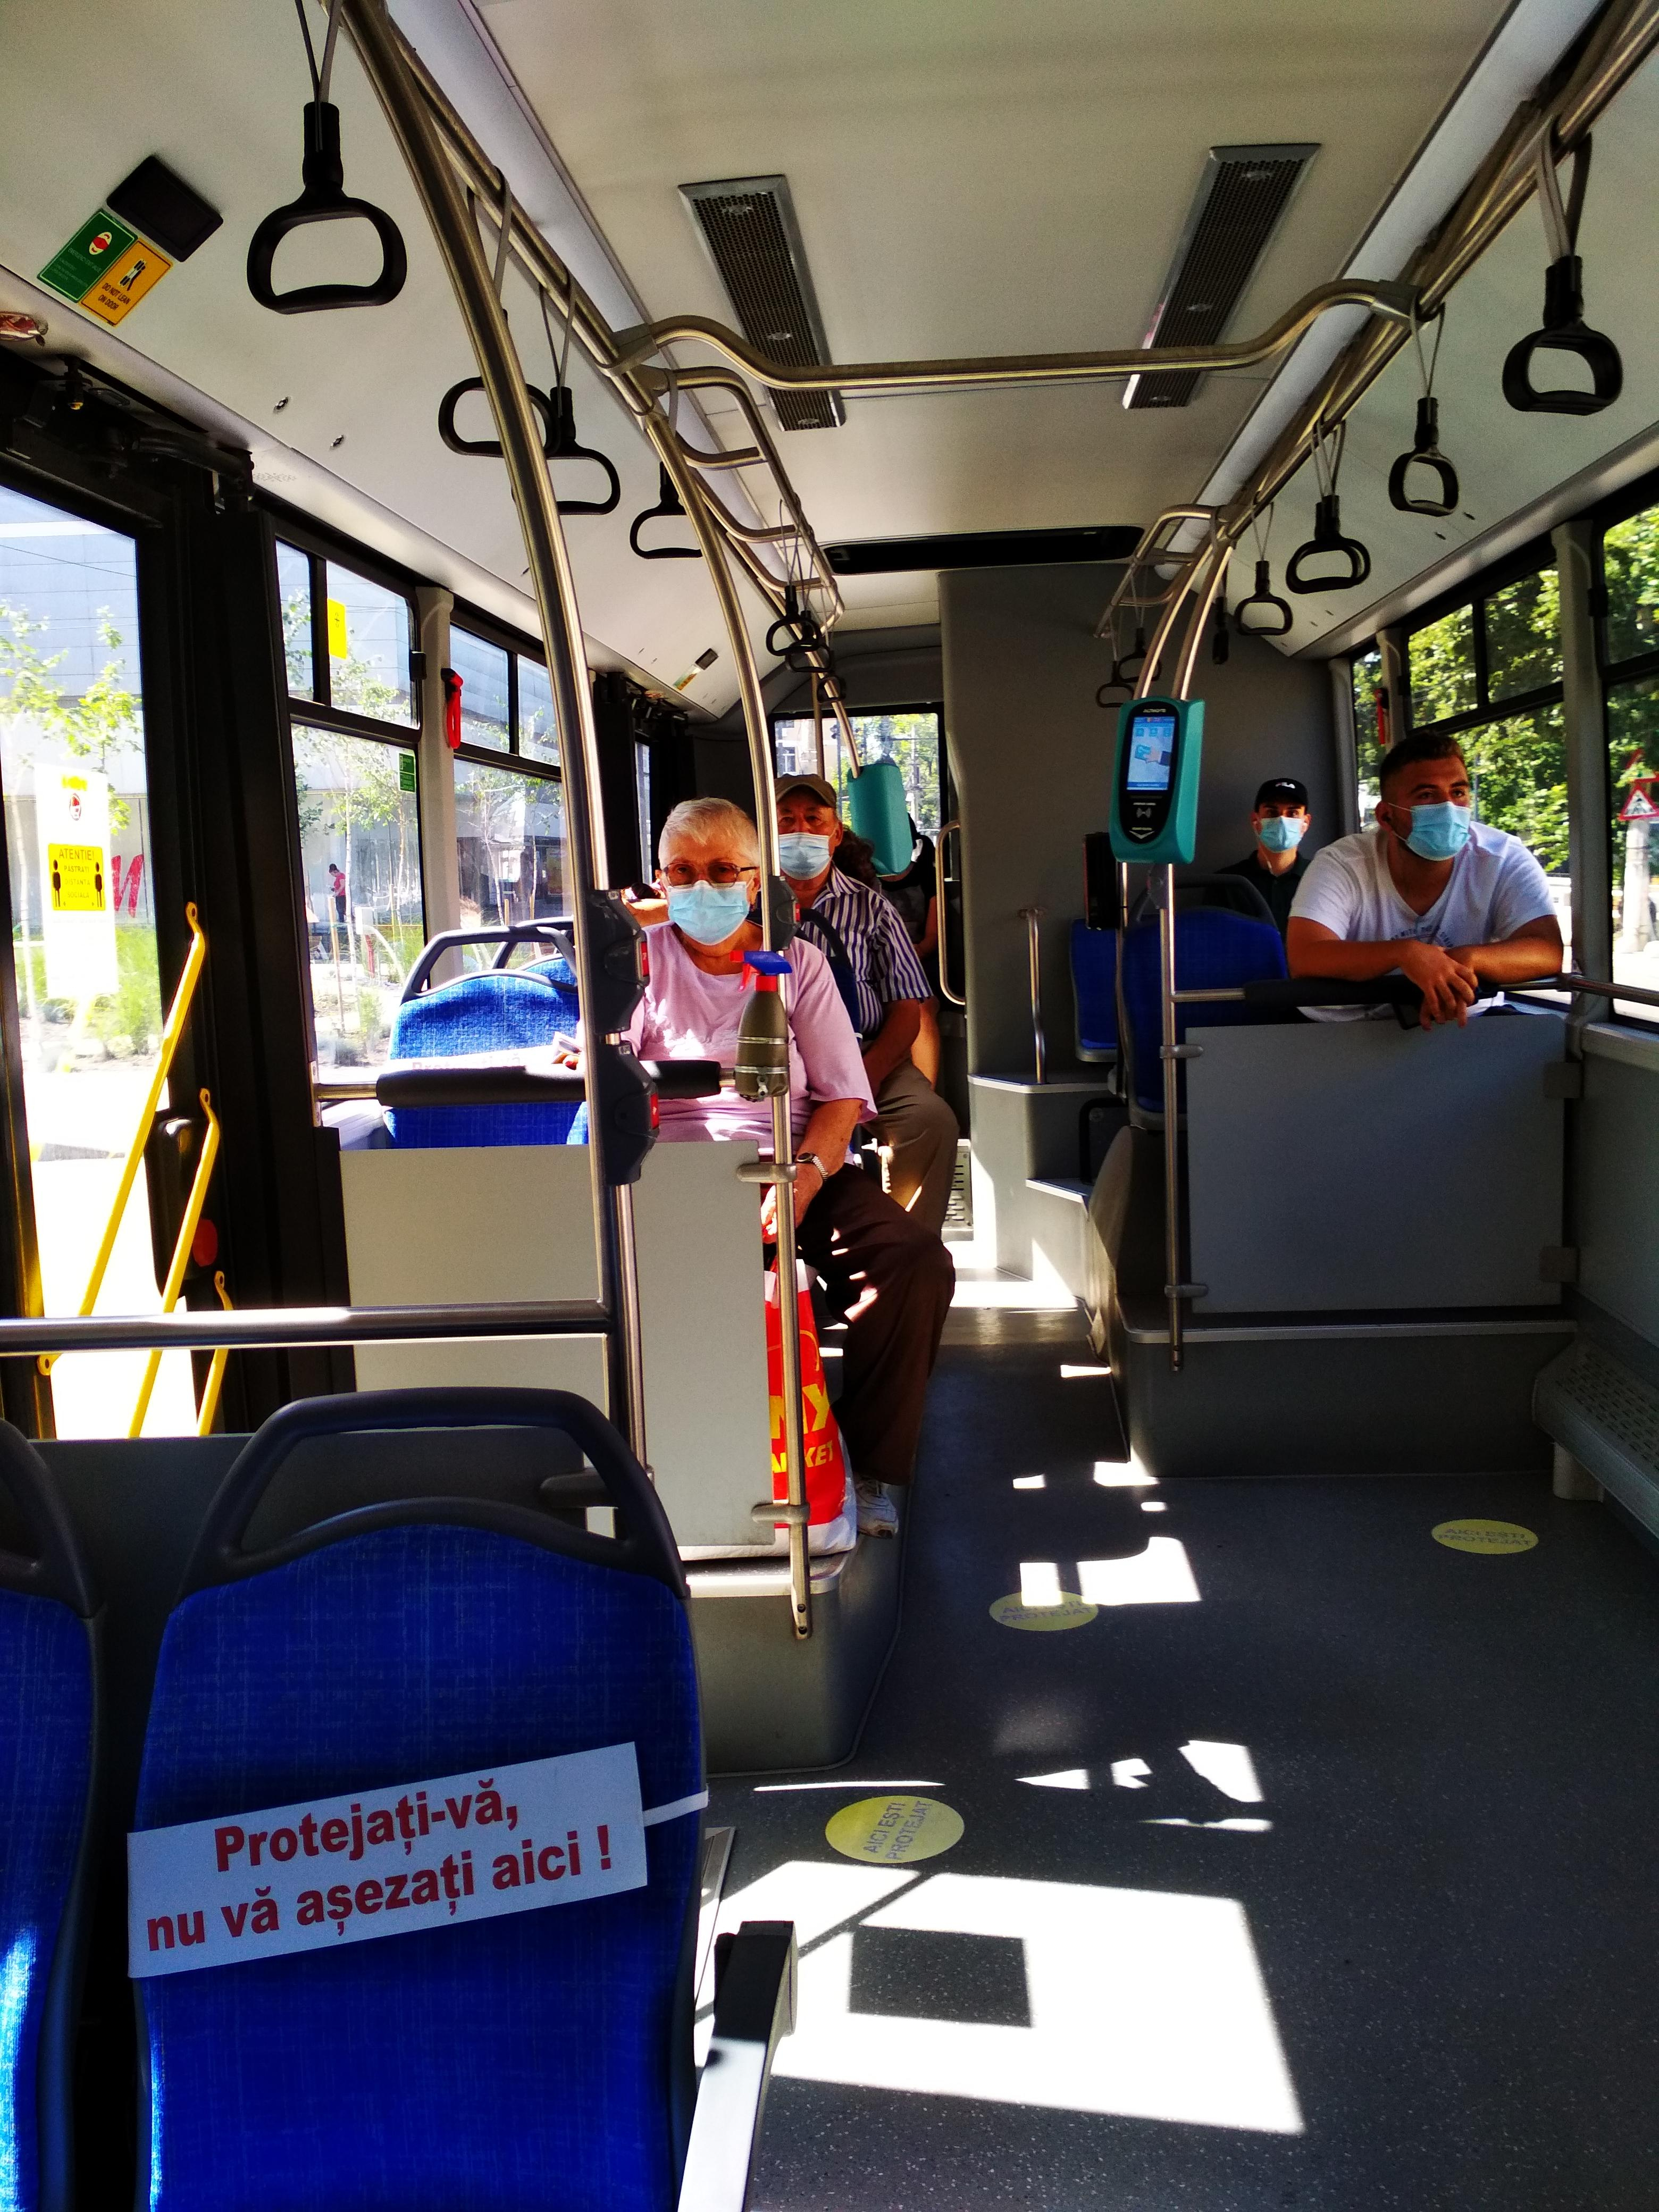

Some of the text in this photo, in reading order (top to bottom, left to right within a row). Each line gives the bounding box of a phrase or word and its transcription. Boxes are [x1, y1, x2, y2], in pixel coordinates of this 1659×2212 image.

[98, 294, 119, 311] ON DOOR
[110, 287, 121, 297] NOT
[118, 293, 131, 305] LEAN
[863, 1829, 890, 1854] AICI
[885, 1800, 932, 1860] PROTEJAT
[148, 1913, 205, 1951] nu
[221, 1886, 279, 1937] vă
[492, 1835, 581, 1890] aici
[598, 1825, 611, 1870] !
